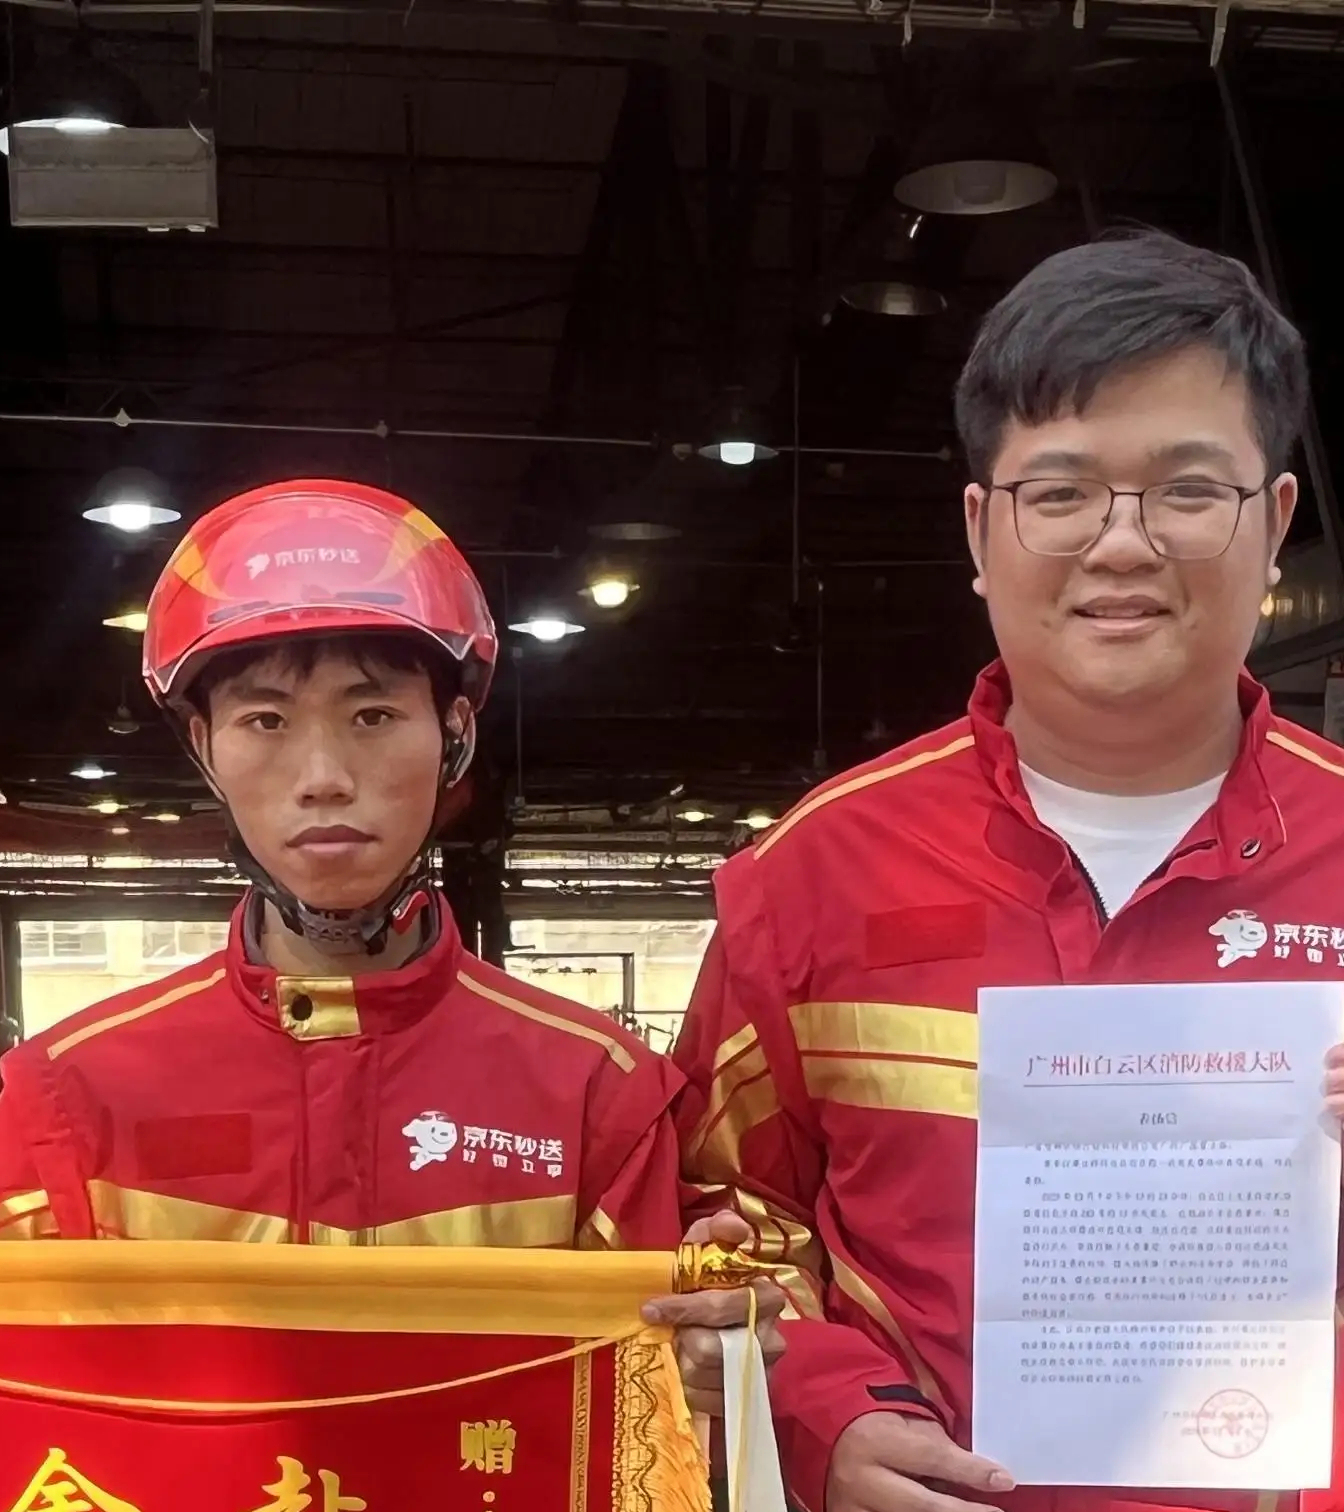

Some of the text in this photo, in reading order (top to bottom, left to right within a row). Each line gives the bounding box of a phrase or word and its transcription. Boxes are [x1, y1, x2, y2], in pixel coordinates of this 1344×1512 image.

[1026, 1050, 1292, 1078] 广州市白云区消防救援大队
[463, 1125, 563, 1162] 京东秒送
